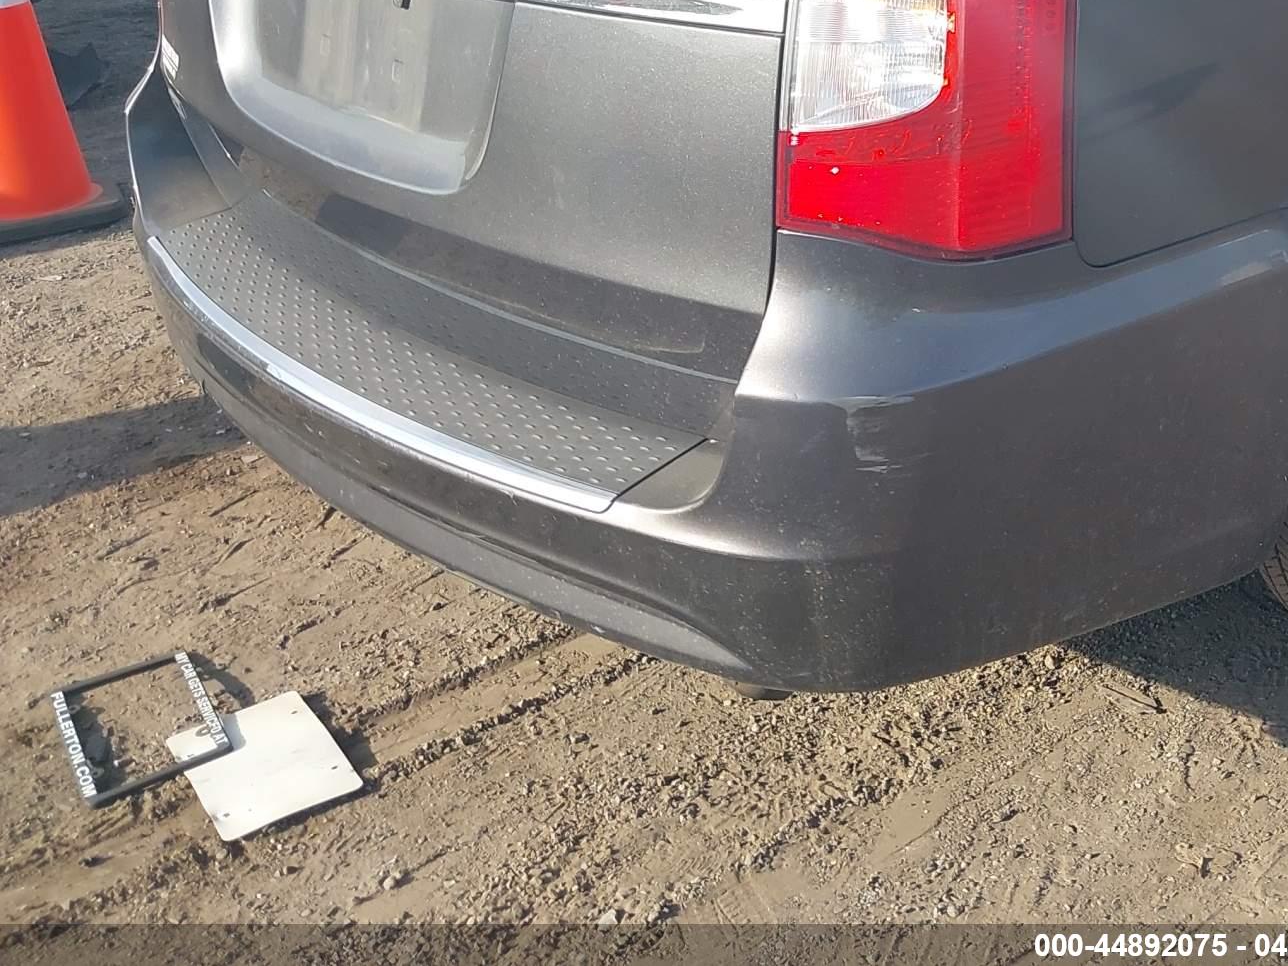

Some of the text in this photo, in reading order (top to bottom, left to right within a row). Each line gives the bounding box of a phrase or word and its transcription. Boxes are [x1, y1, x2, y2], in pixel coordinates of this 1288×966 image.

[50, 691, 98, 798] FULLERTON.COM
[174, 651, 228, 745] MY CAR GETS SERVICED AT
